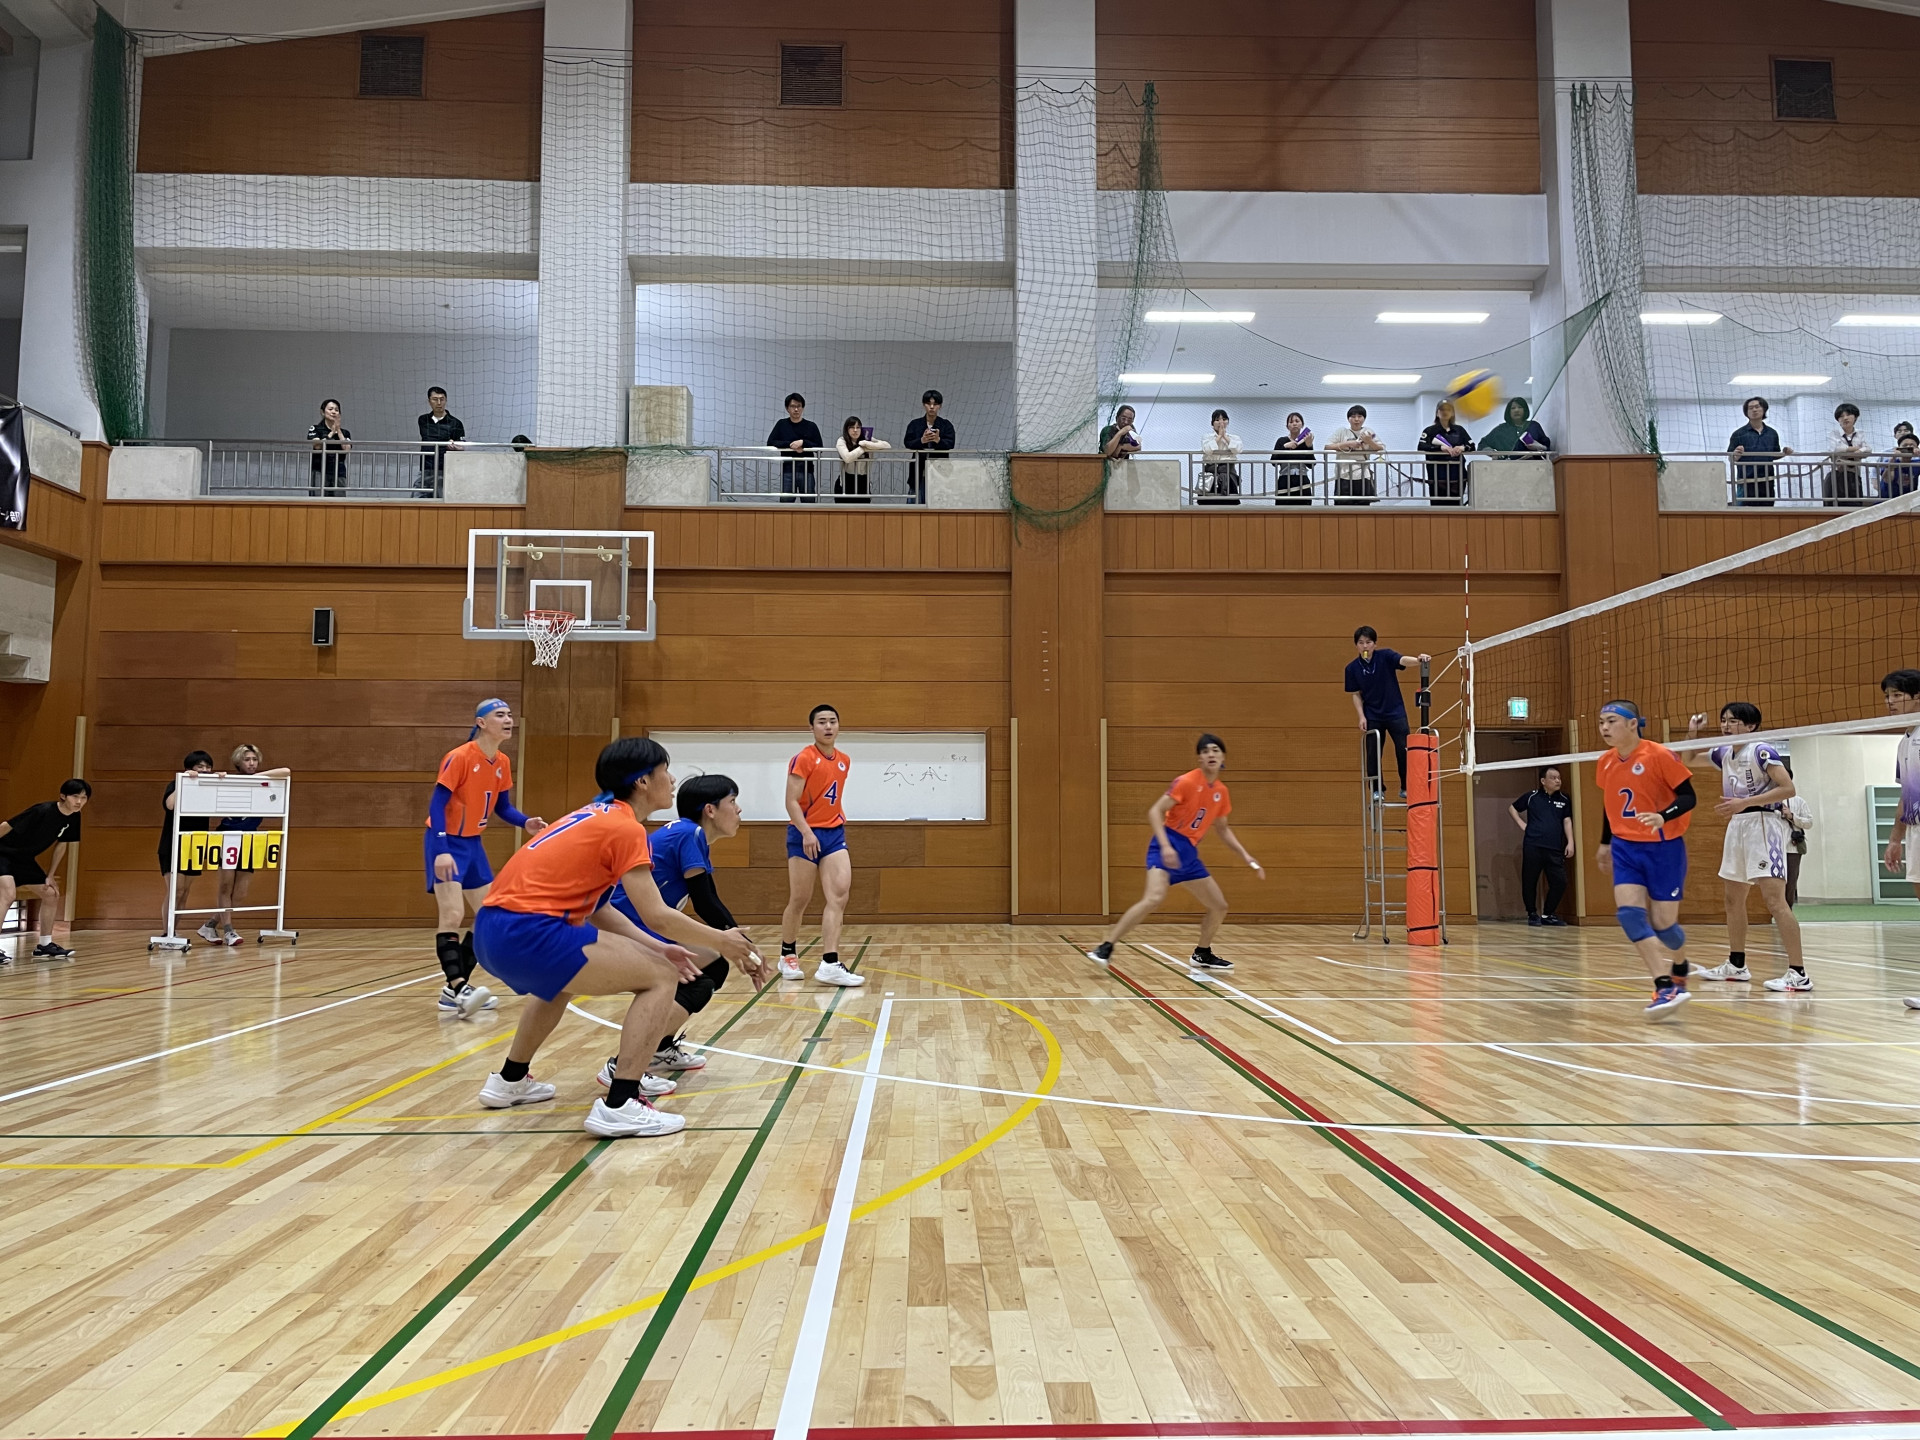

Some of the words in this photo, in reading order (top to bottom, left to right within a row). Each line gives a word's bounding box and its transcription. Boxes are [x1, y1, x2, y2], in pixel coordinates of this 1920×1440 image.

[824, 780, 838, 805] 4
[1618, 788, 1636, 818] 2
[478, 791, 492, 828] 1
[196, 846, 221, 865] 10
[226, 847, 238, 865] 3
[268, 844, 279, 863] 6
